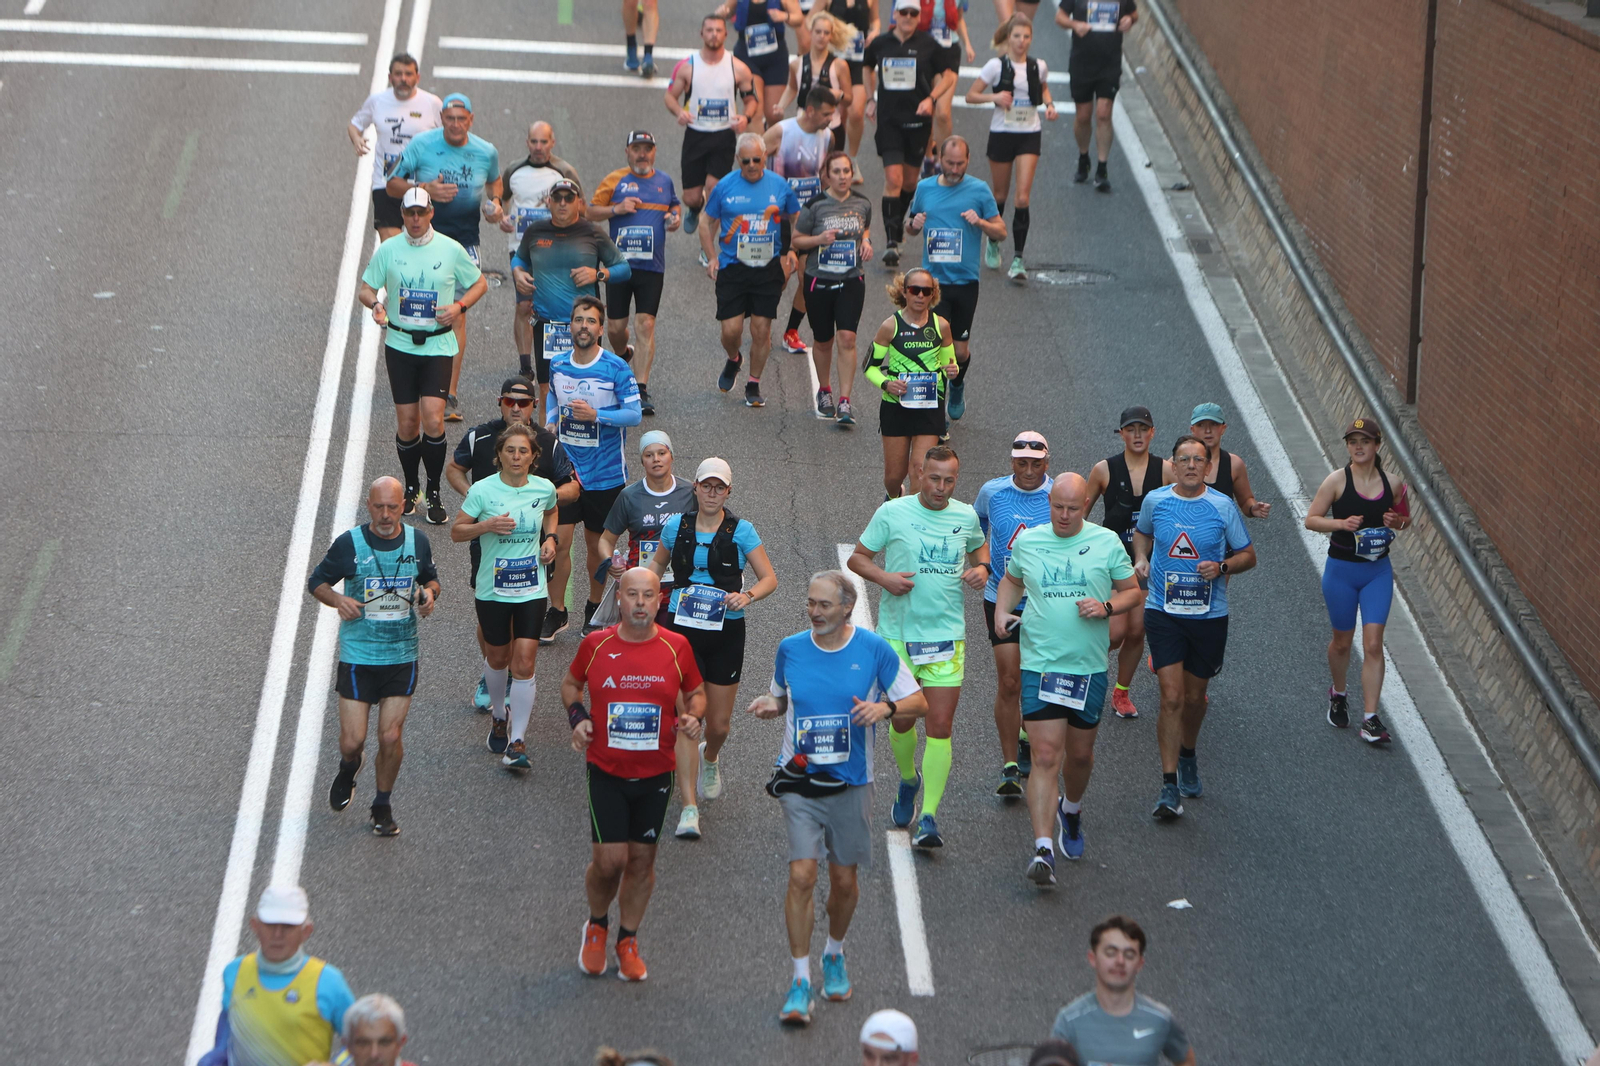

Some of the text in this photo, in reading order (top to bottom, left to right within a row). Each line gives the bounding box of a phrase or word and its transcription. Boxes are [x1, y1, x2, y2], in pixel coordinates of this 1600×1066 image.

[750, 220, 770, 231] FAST
[832, 241, 851, 249] ZURICH
[410, 302, 424, 310] 12021
[904, 341, 934, 349] COSTANZA
[566, 429, 590, 438] GONÇALVES
[510, 559, 533, 568] ZURICH
[503, 580, 531, 588] ELISABETTA
[697, 586, 722, 599] ZURICH
[1043, 590, 1086, 600] SEVILLA'24
[693, 610, 708, 619] LOTTE
[921, 645, 939, 654] TURBO
[620, 675, 665, 683] ARMUNDIA
[627, 706, 656, 714] ZURICH
[624, 721, 645, 730] 12003
[815, 719, 843, 728] ZURICH
[813, 734, 834, 744] 12442
[815, 744, 834, 753] PAOLO
